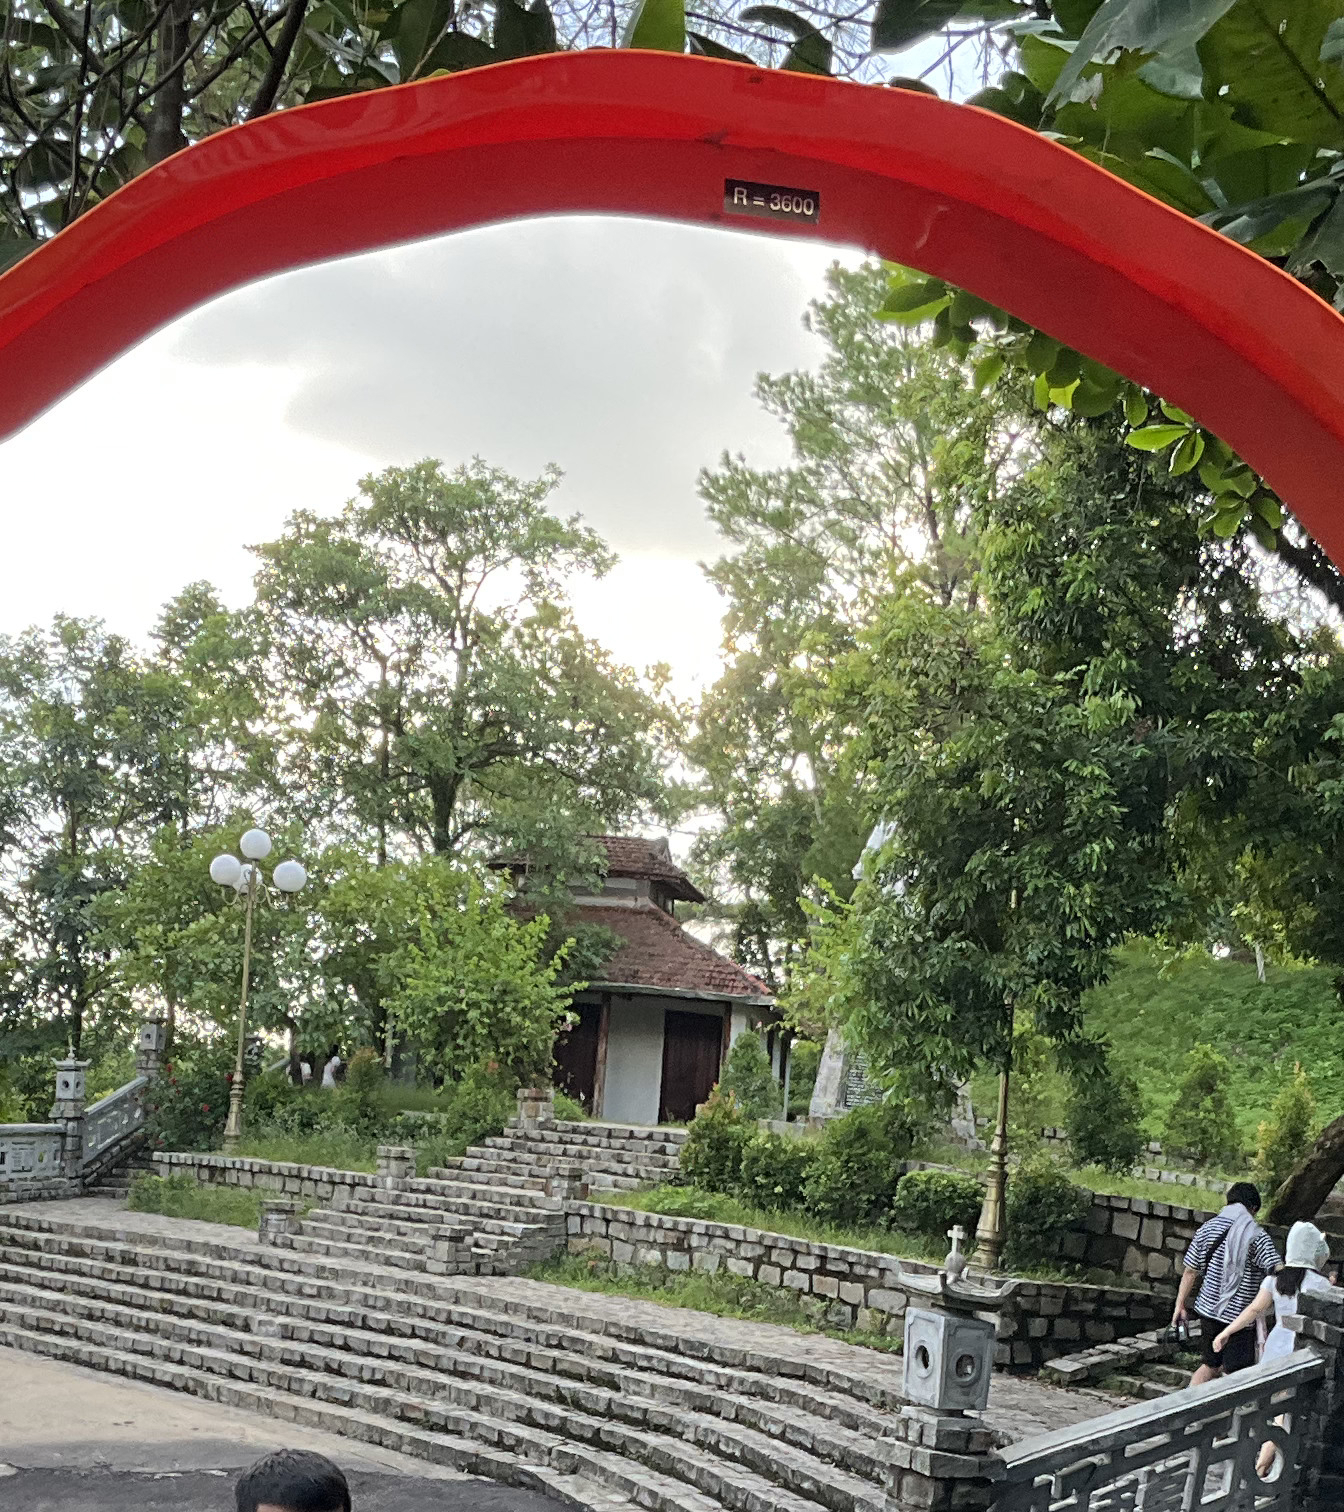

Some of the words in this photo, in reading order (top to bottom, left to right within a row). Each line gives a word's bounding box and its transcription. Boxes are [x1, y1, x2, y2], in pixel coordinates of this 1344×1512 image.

[734, 187, 747, 205] R
[753, 196, 765, 206] =
[770, 193, 814, 215] 3600
